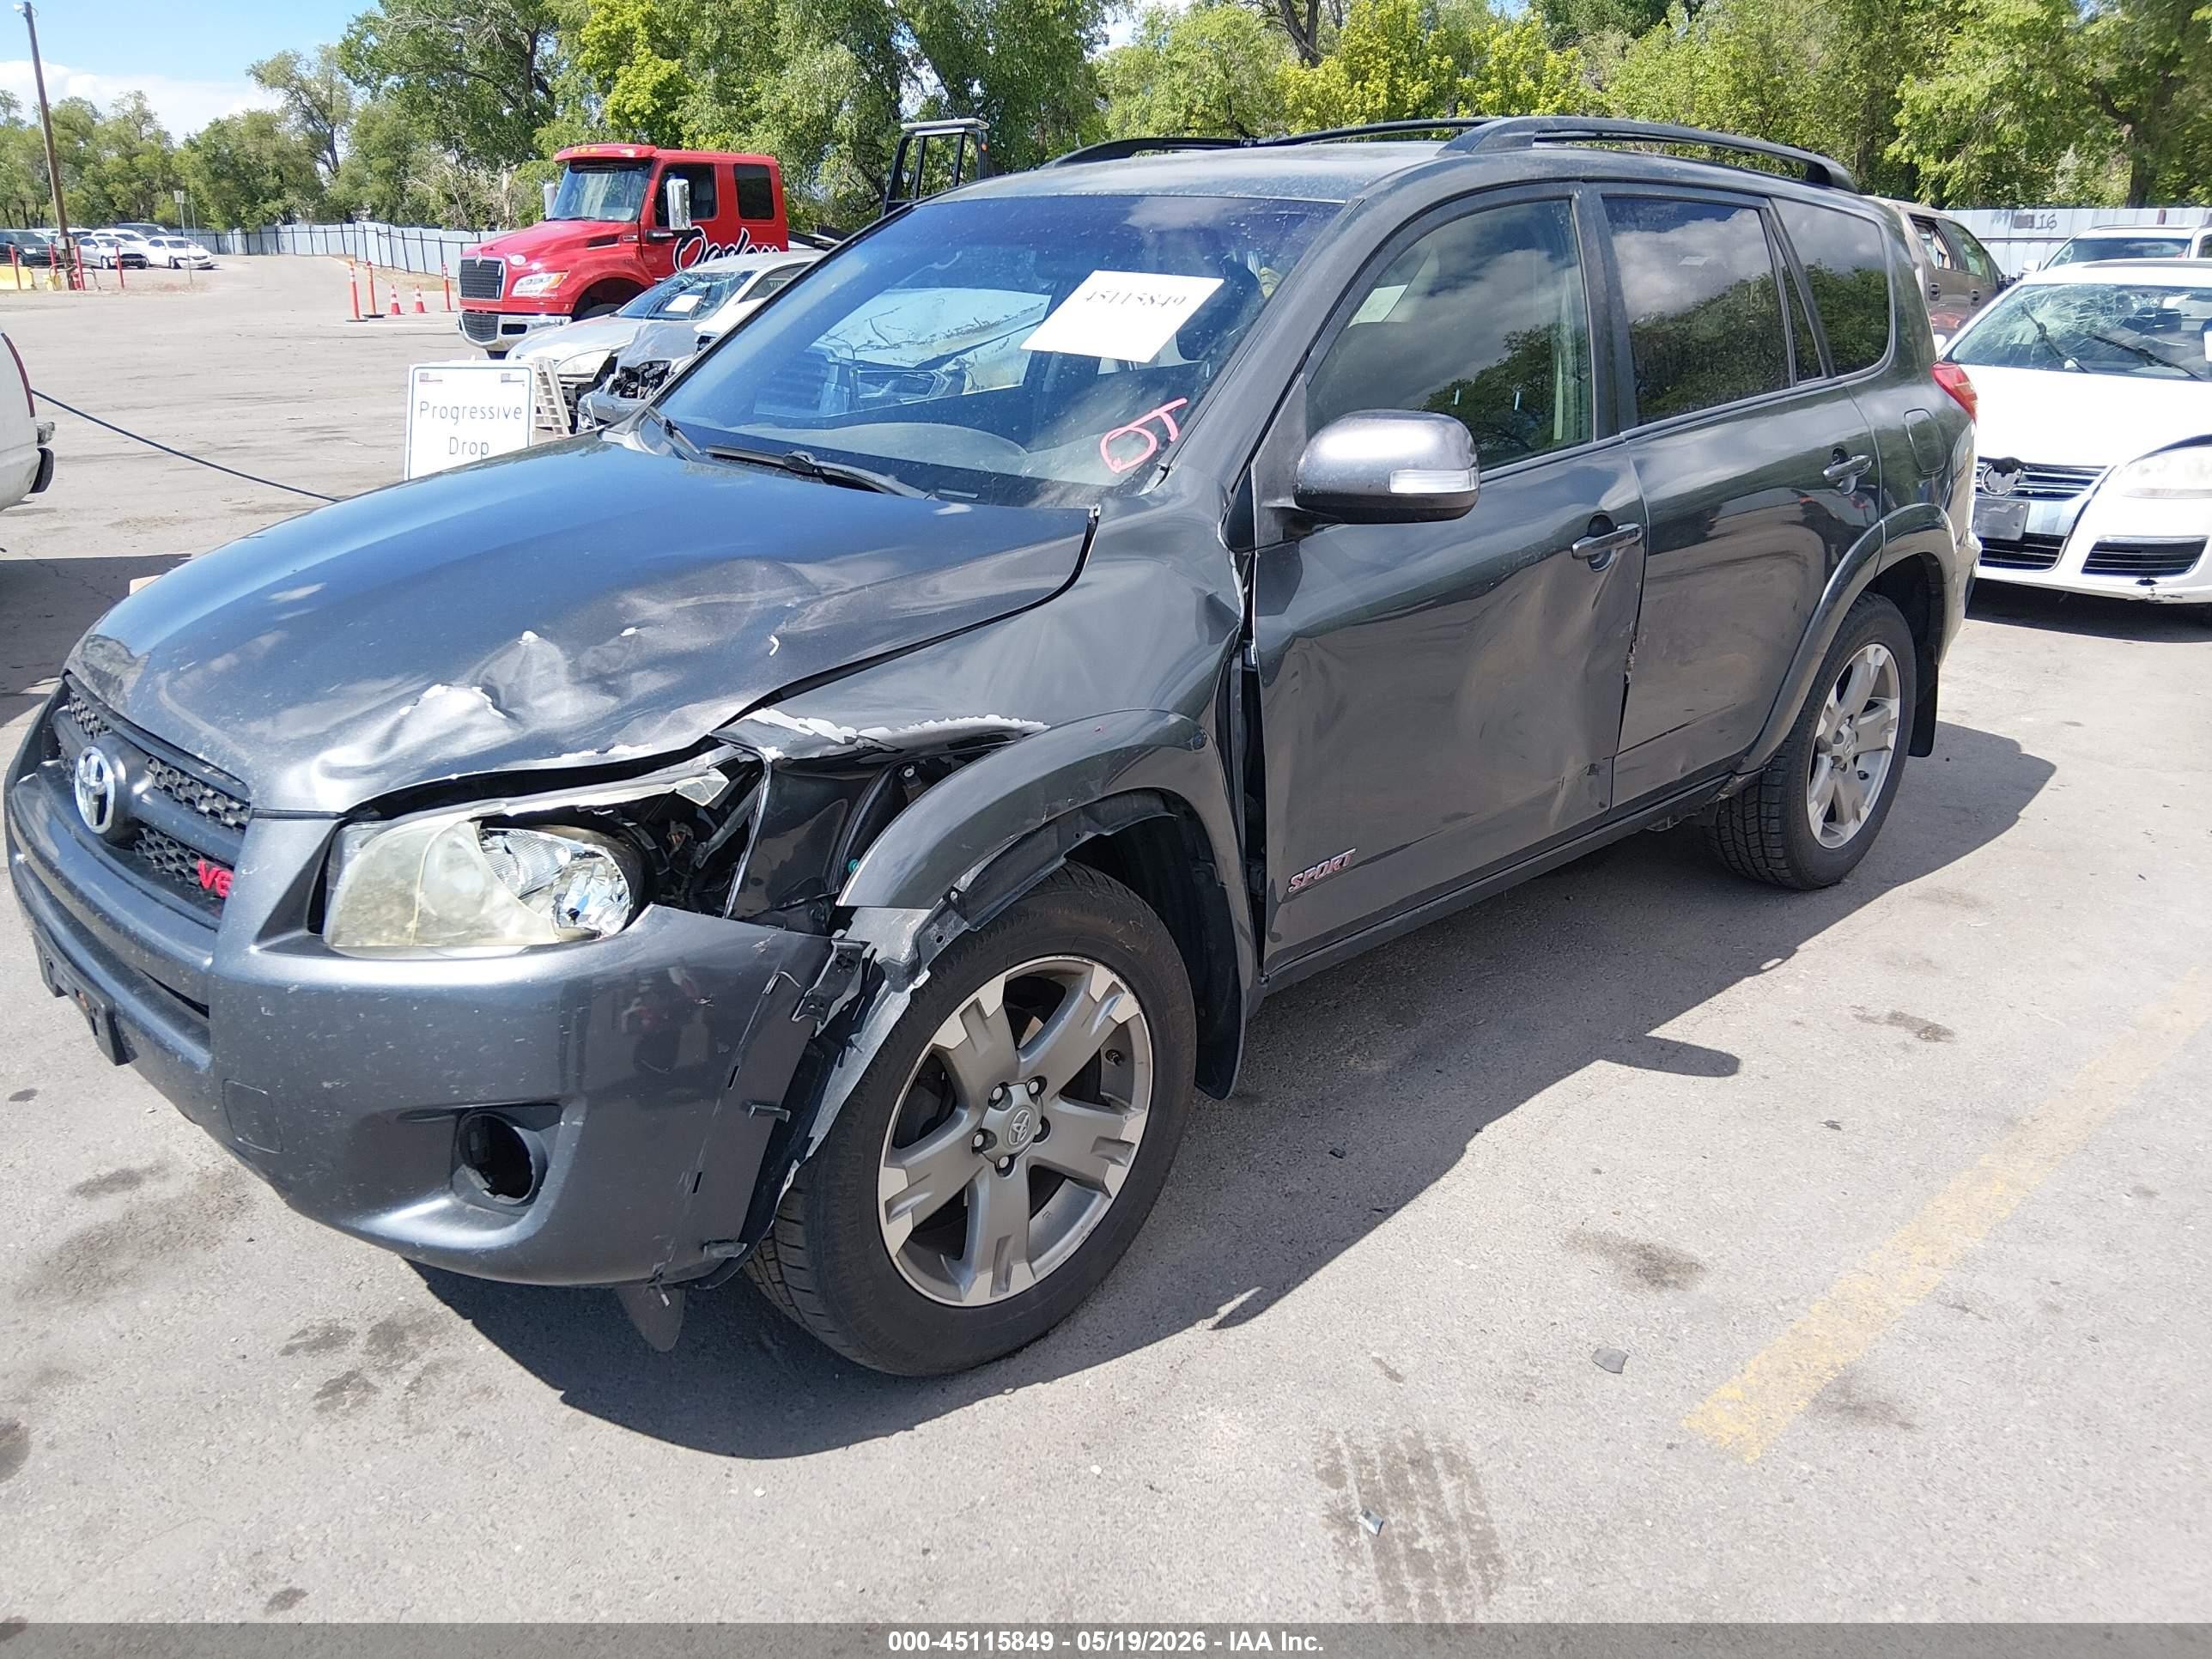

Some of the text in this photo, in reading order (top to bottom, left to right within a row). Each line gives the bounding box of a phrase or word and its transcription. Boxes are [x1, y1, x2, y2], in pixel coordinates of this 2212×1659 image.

[419, 401, 523, 426] Progressive
[449, 436, 489, 460] Drop
[198, 859, 234, 897] V6
[1287, 848, 1357, 893] SPORT
